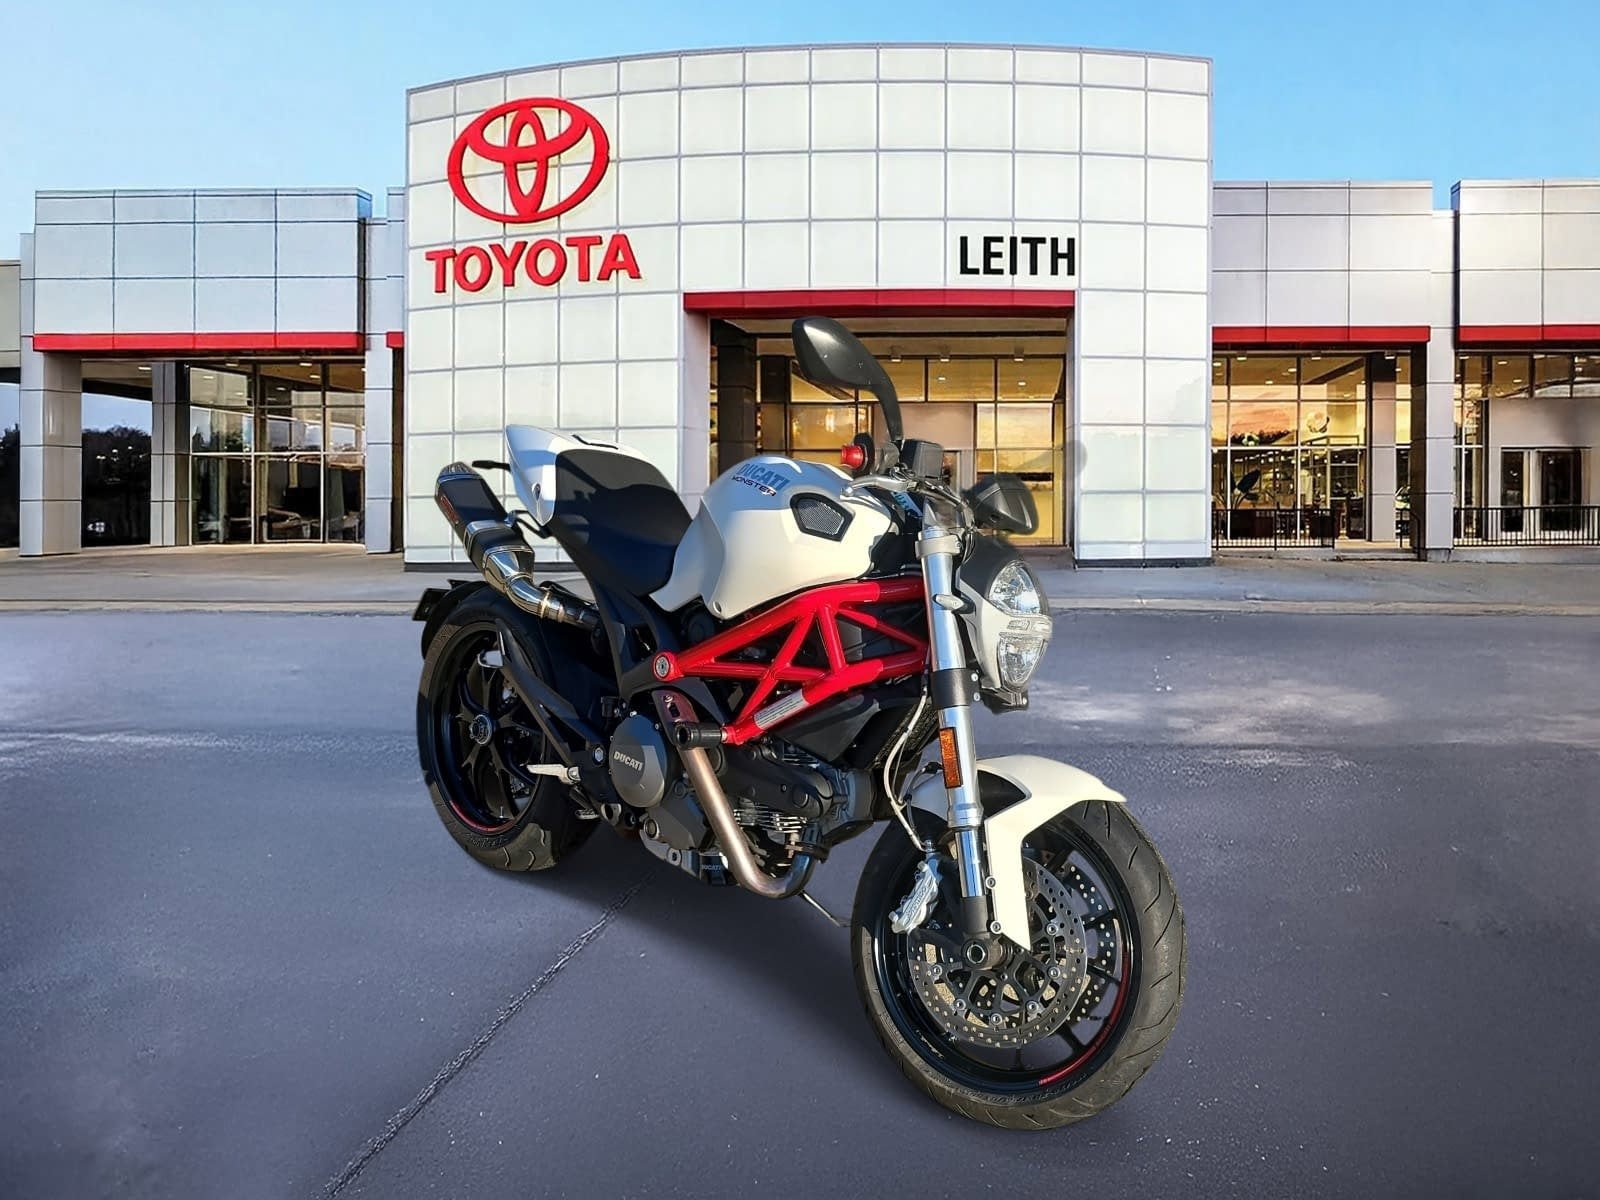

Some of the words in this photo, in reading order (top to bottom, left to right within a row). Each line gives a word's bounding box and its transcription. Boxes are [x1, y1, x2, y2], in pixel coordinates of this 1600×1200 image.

[425, 234, 641, 293] TOYOTA
[960, 236, 1075, 276] LEITH
[731, 475, 777, 497] MONSTER
[735, 463, 791, 491] DUCATI
[613, 750, 643, 771] DUCATI
